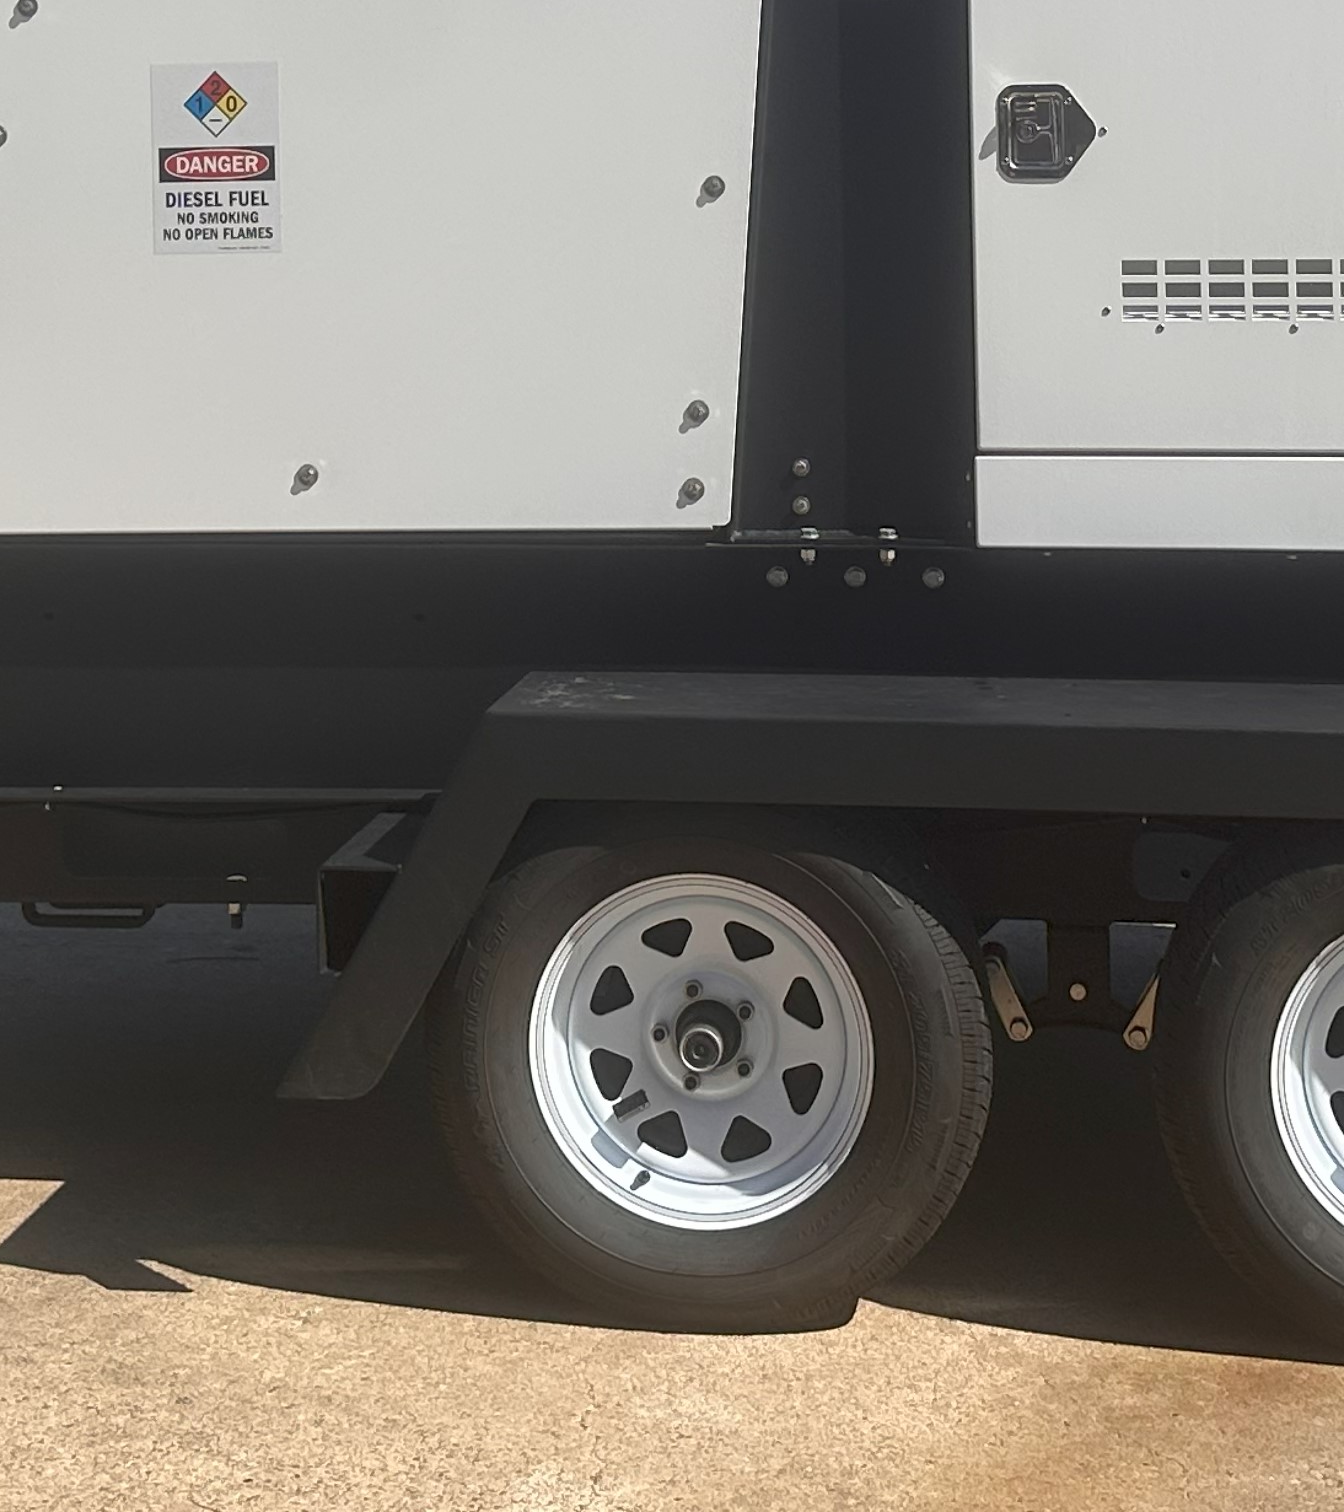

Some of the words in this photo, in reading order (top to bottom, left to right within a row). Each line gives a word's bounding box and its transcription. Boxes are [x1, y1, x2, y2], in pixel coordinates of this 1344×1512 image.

[210, 80, 222, 96] 2
[195, 96, 203, 113] 1
[226, 95, 237, 113] 0
[176, 156, 259, 174] DANGER
[165, 192, 223, 208] DIESEL
[229, 190, 269, 206] FUEL
[177, 213, 195, 224] NO
[199, 211, 259, 224] SMOKING
[163, 228, 181, 241] NO
[185, 227, 218, 240] OPEN
[223, 226, 273, 239] FLAMES
